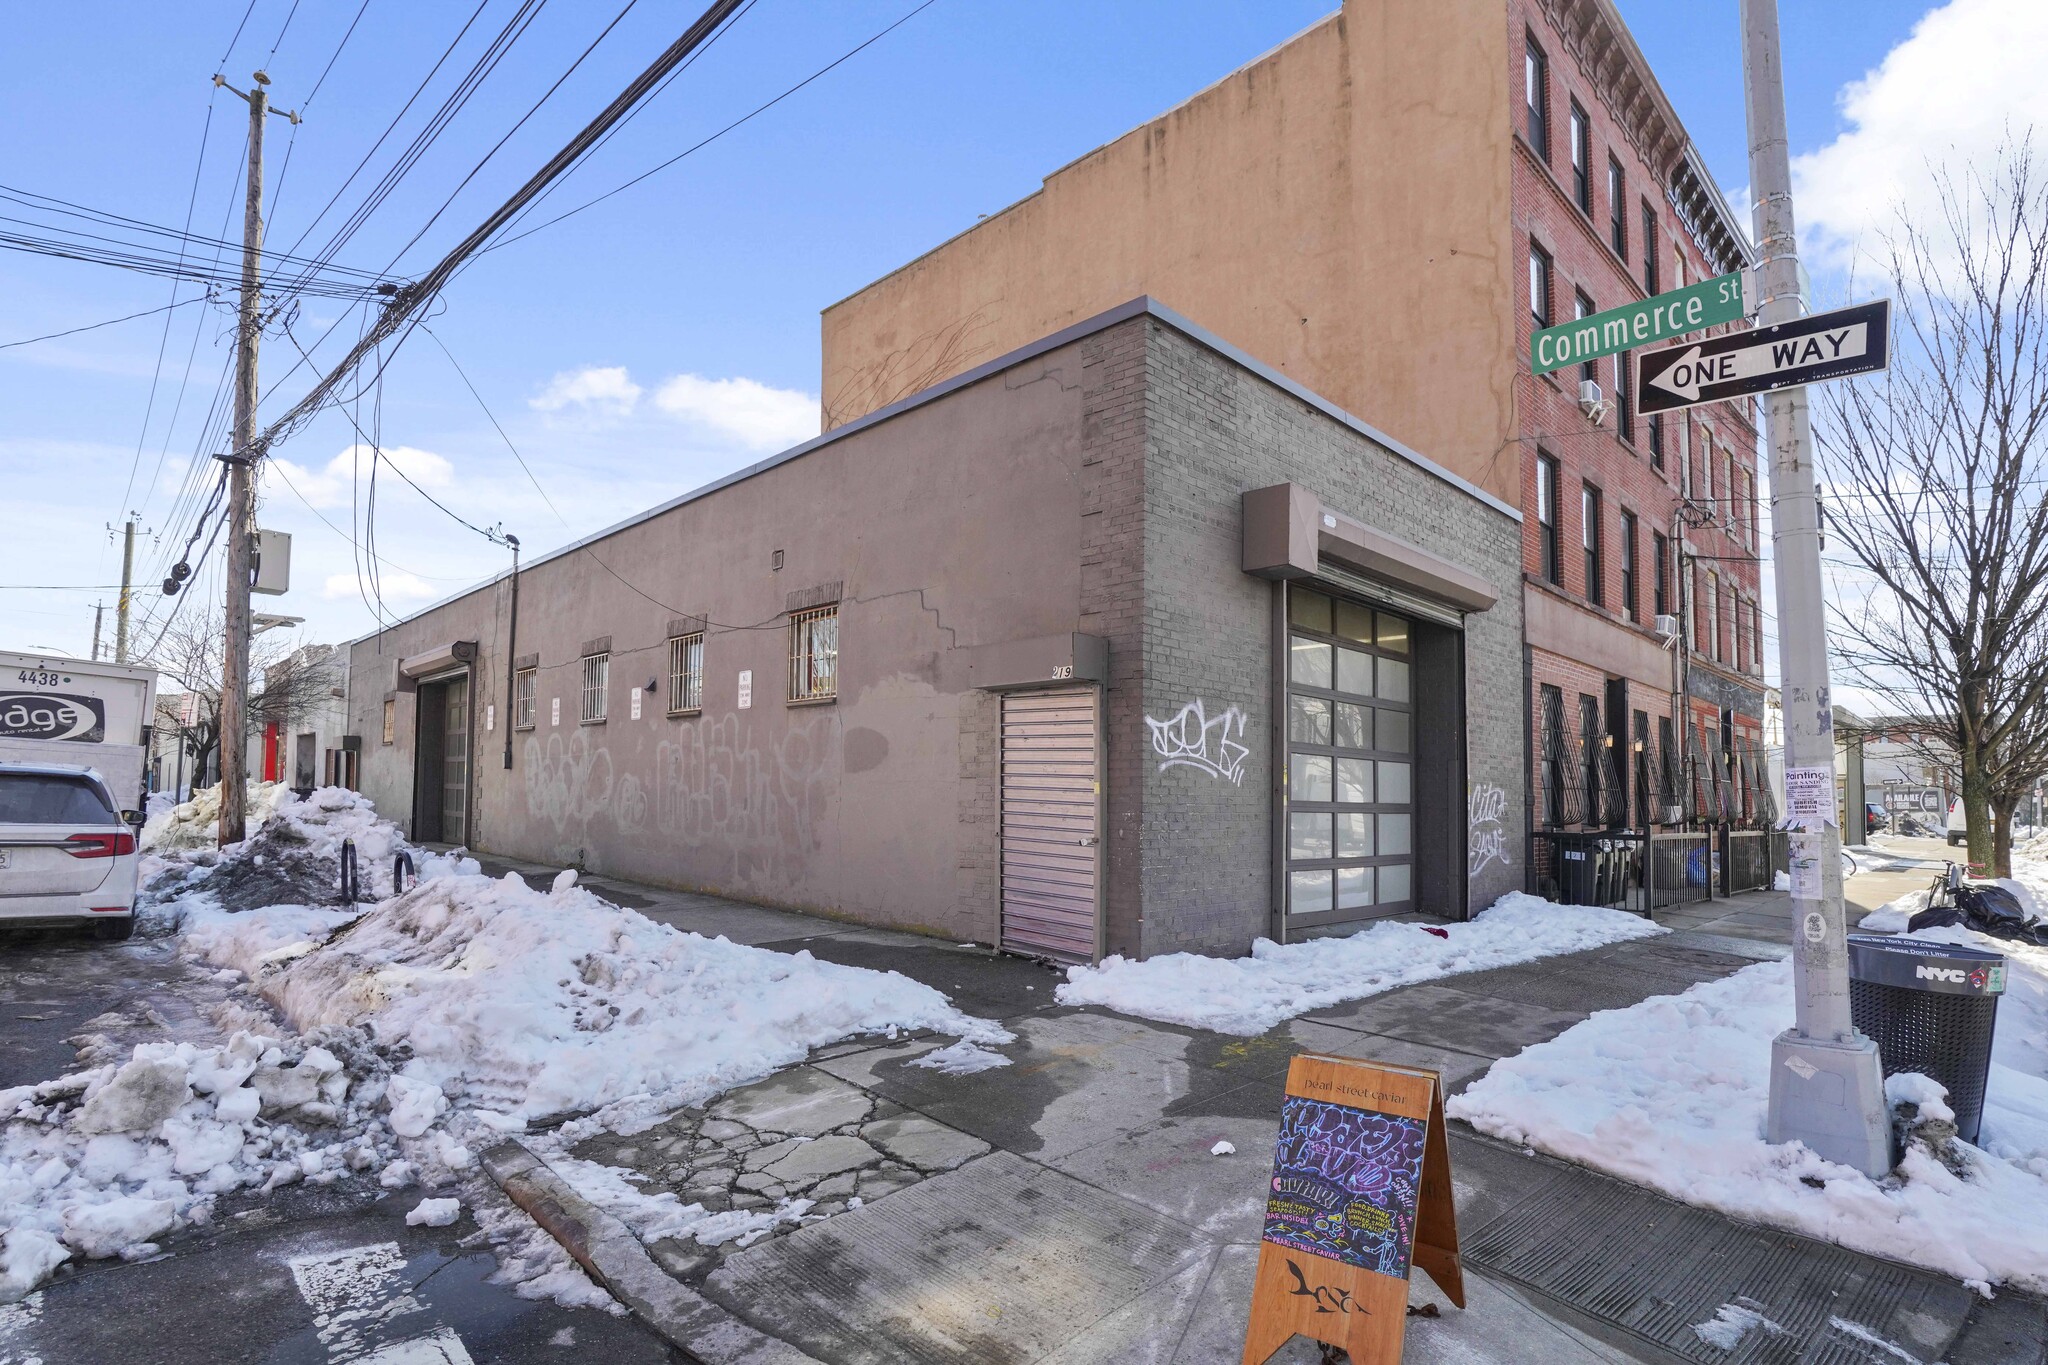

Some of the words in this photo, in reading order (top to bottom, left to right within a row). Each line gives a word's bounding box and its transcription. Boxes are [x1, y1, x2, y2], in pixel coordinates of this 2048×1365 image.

[1538, 296, 1703, 367] Commerce
[1718, 278, 1740, 304] St
[1672, 354, 1737, 388] ONE
[1772, 329, 1851, 369] WAY
[1812, 365, 1875, 380] TRANSPORTATION
[18, 670, 59, 687] 4438
[1052, 666, 1072, 679] 219
[1786, 771, 1825, 780] Painting
[1885, 946, 1909, 954] Please
[1916, 965, 1966, 983] NYC
[1304, 1079, 1333, 1091] pearl
[1336, 1084, 1368, 1098] street
[1371, 1091, 1407, 1104] caviar
[1268, 1199, 1290, 1208] FRESH
[1295, 1204, 1316, 1213] TASTY
[1266, 1212, 1281, 1220] BAR
[1397, 1214, 1408, 1233] DIVE
[1272, 1236, 1292, 1248] PEARL
[1292, 1241, 1317, 1254] STREET
